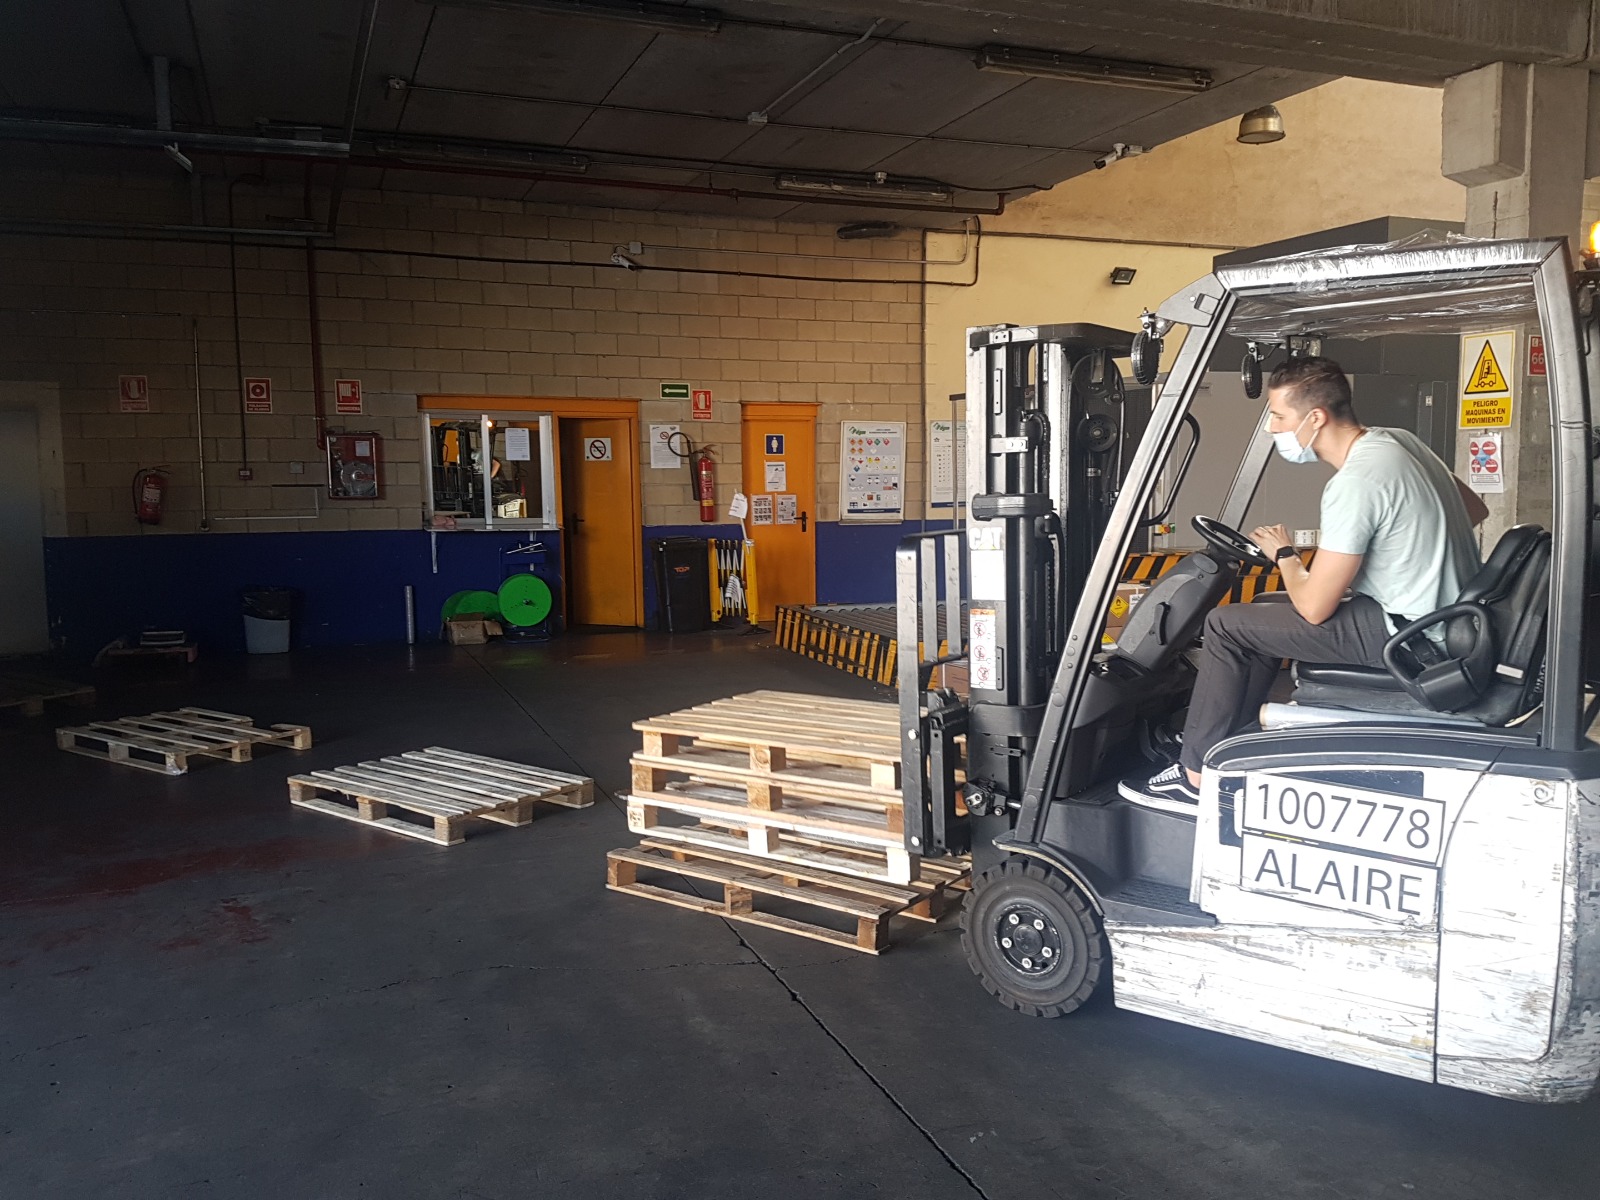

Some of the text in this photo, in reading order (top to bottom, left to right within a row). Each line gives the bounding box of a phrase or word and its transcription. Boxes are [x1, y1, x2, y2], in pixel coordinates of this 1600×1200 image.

[1465, 408, 1496, 416] MAQUINAS
[1466, 416, 1504, 424] MOVIMIENTO
[968, 527, 1003, 550] CAT
[1258, 783, 1430, 849] 1007778
[1254, 848, 1422, 916] ALAIRE
